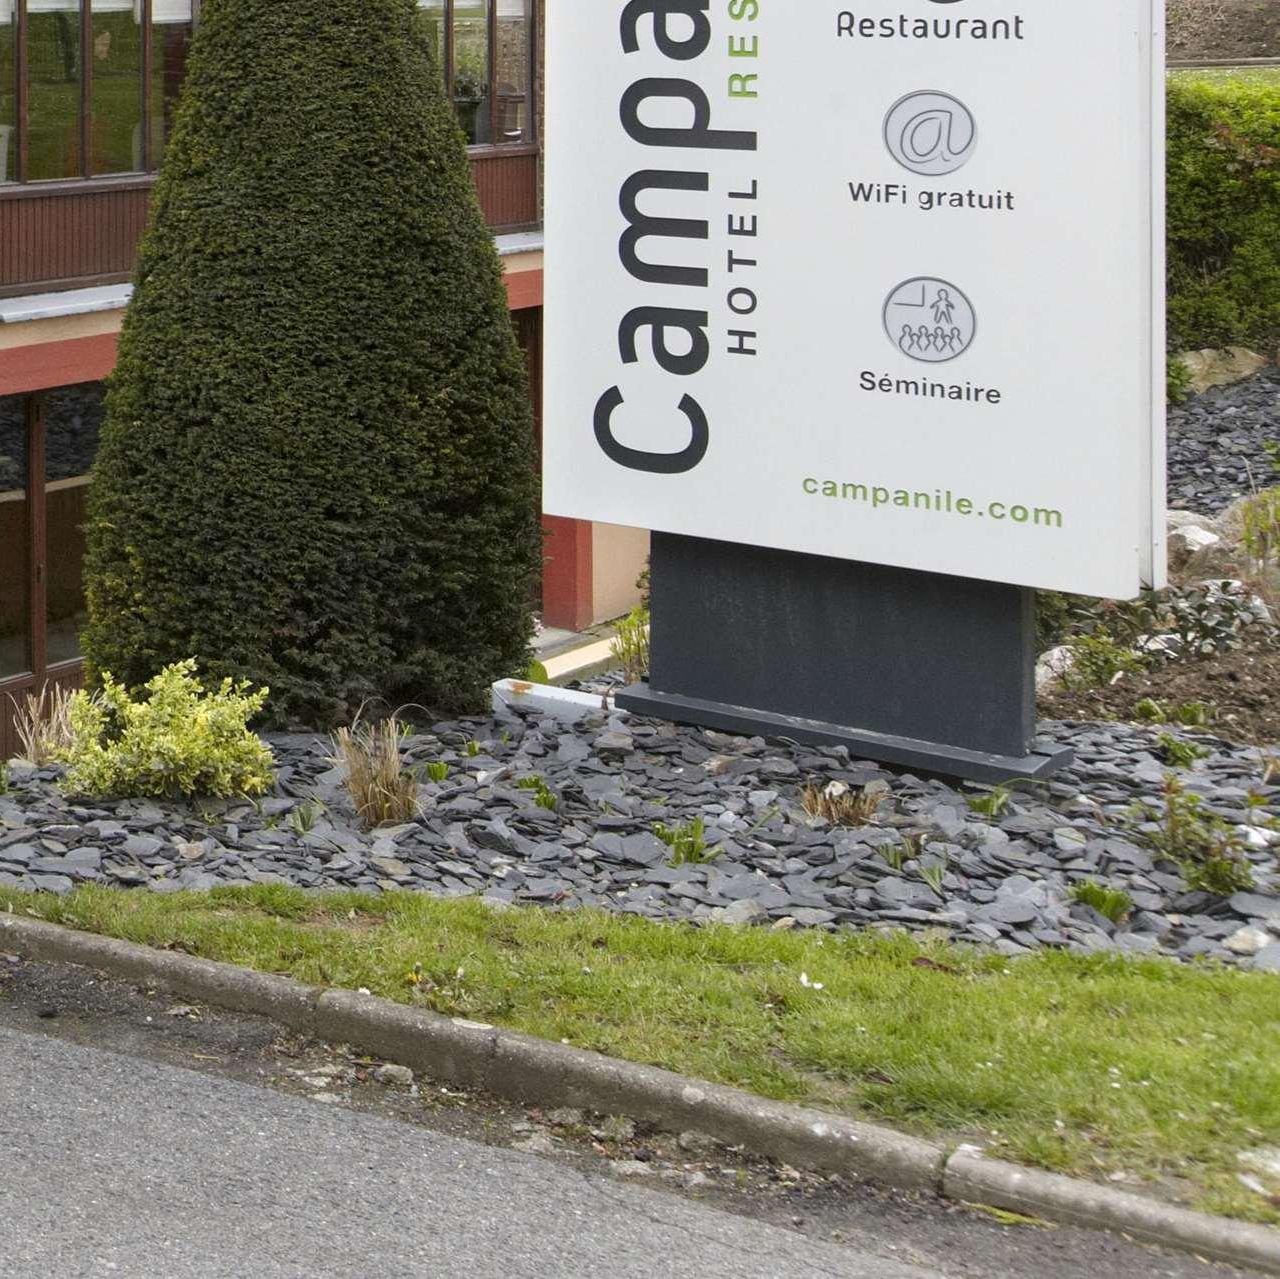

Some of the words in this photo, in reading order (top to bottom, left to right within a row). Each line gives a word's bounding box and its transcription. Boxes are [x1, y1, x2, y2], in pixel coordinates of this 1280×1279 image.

[837, 10, 1024, 41] Restaurant
[849, 182, 908, 206] WiFi
[918, 188, 1015, 212] gratuit
[727, 179, 759, 356] HOTEL
[859, 371, 1003, 405] Séminaire
[802, 477, 1064, 529] campanile.com
